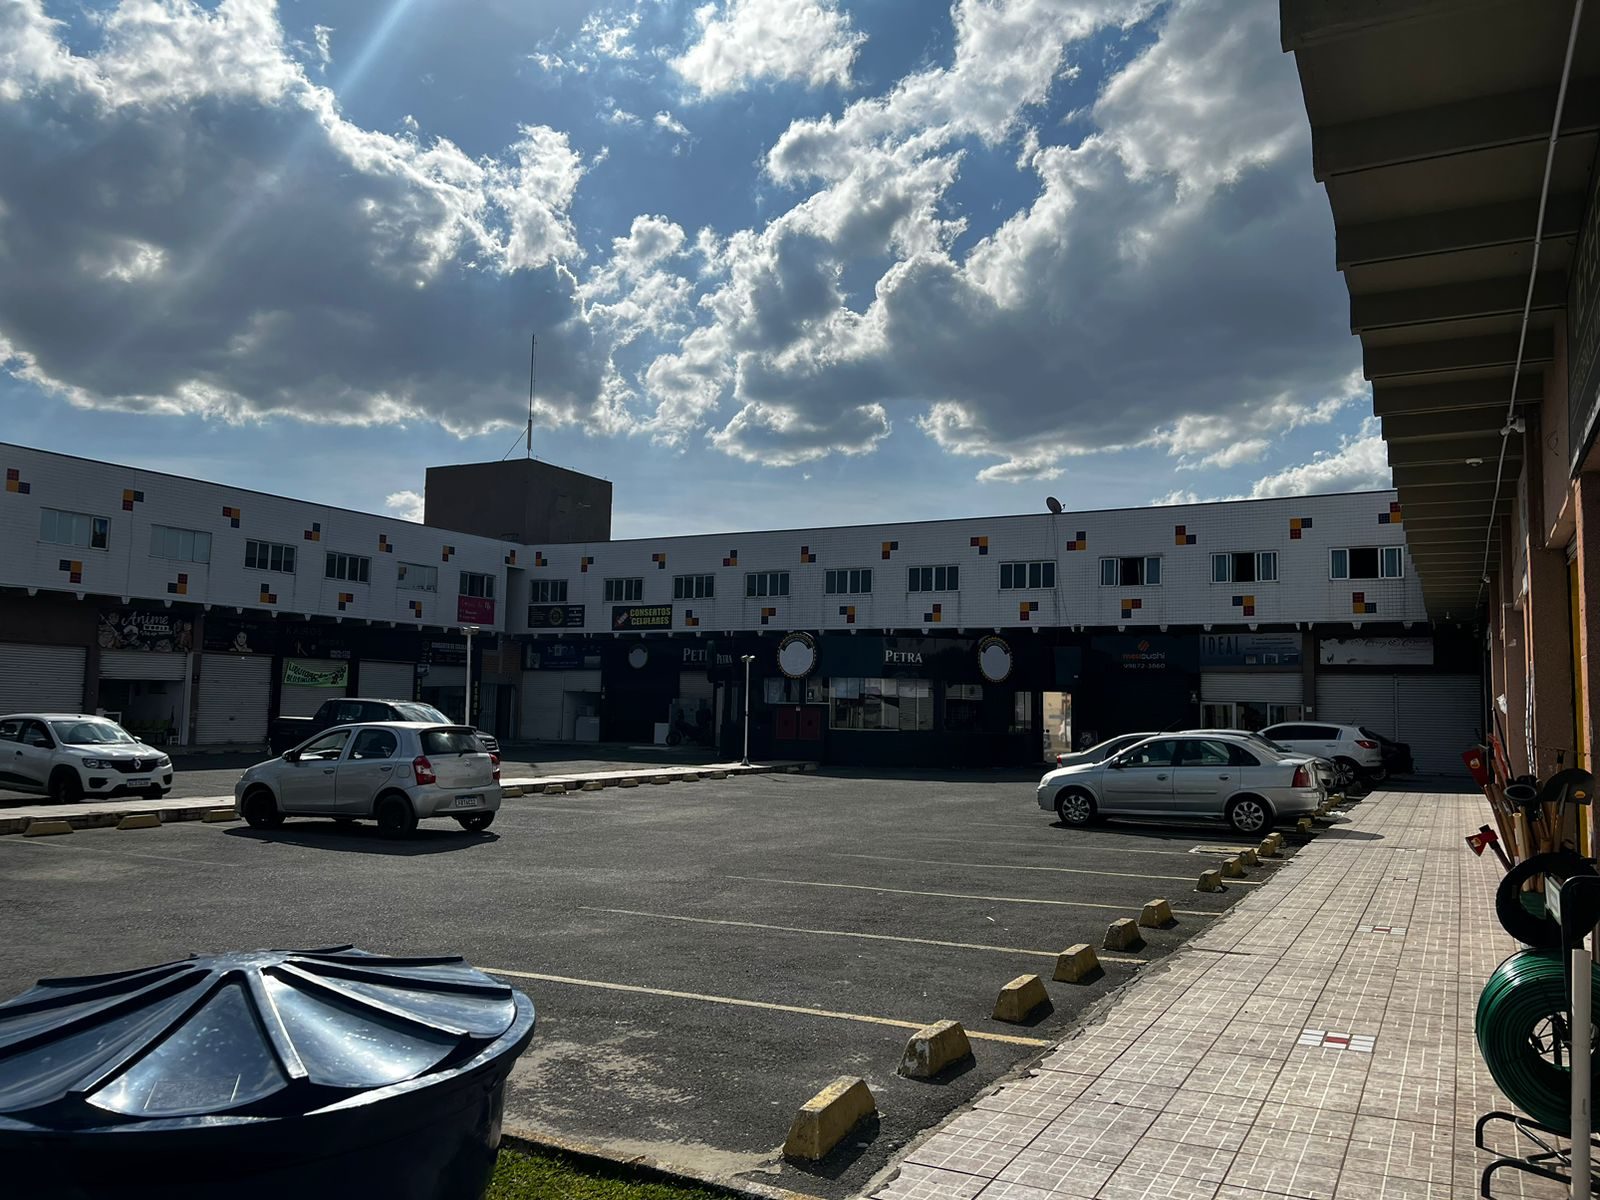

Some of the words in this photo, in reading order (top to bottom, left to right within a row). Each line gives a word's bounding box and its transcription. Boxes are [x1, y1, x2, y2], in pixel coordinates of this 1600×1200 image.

[121, 611, 169, 626] Anime
[630, 608, 671, 617] CONSERTOS
[631, 616, 670, 625] CELULARES
[1202, 636, 1240, 656] IDEAL
[683, 648, 708, 662] PET
